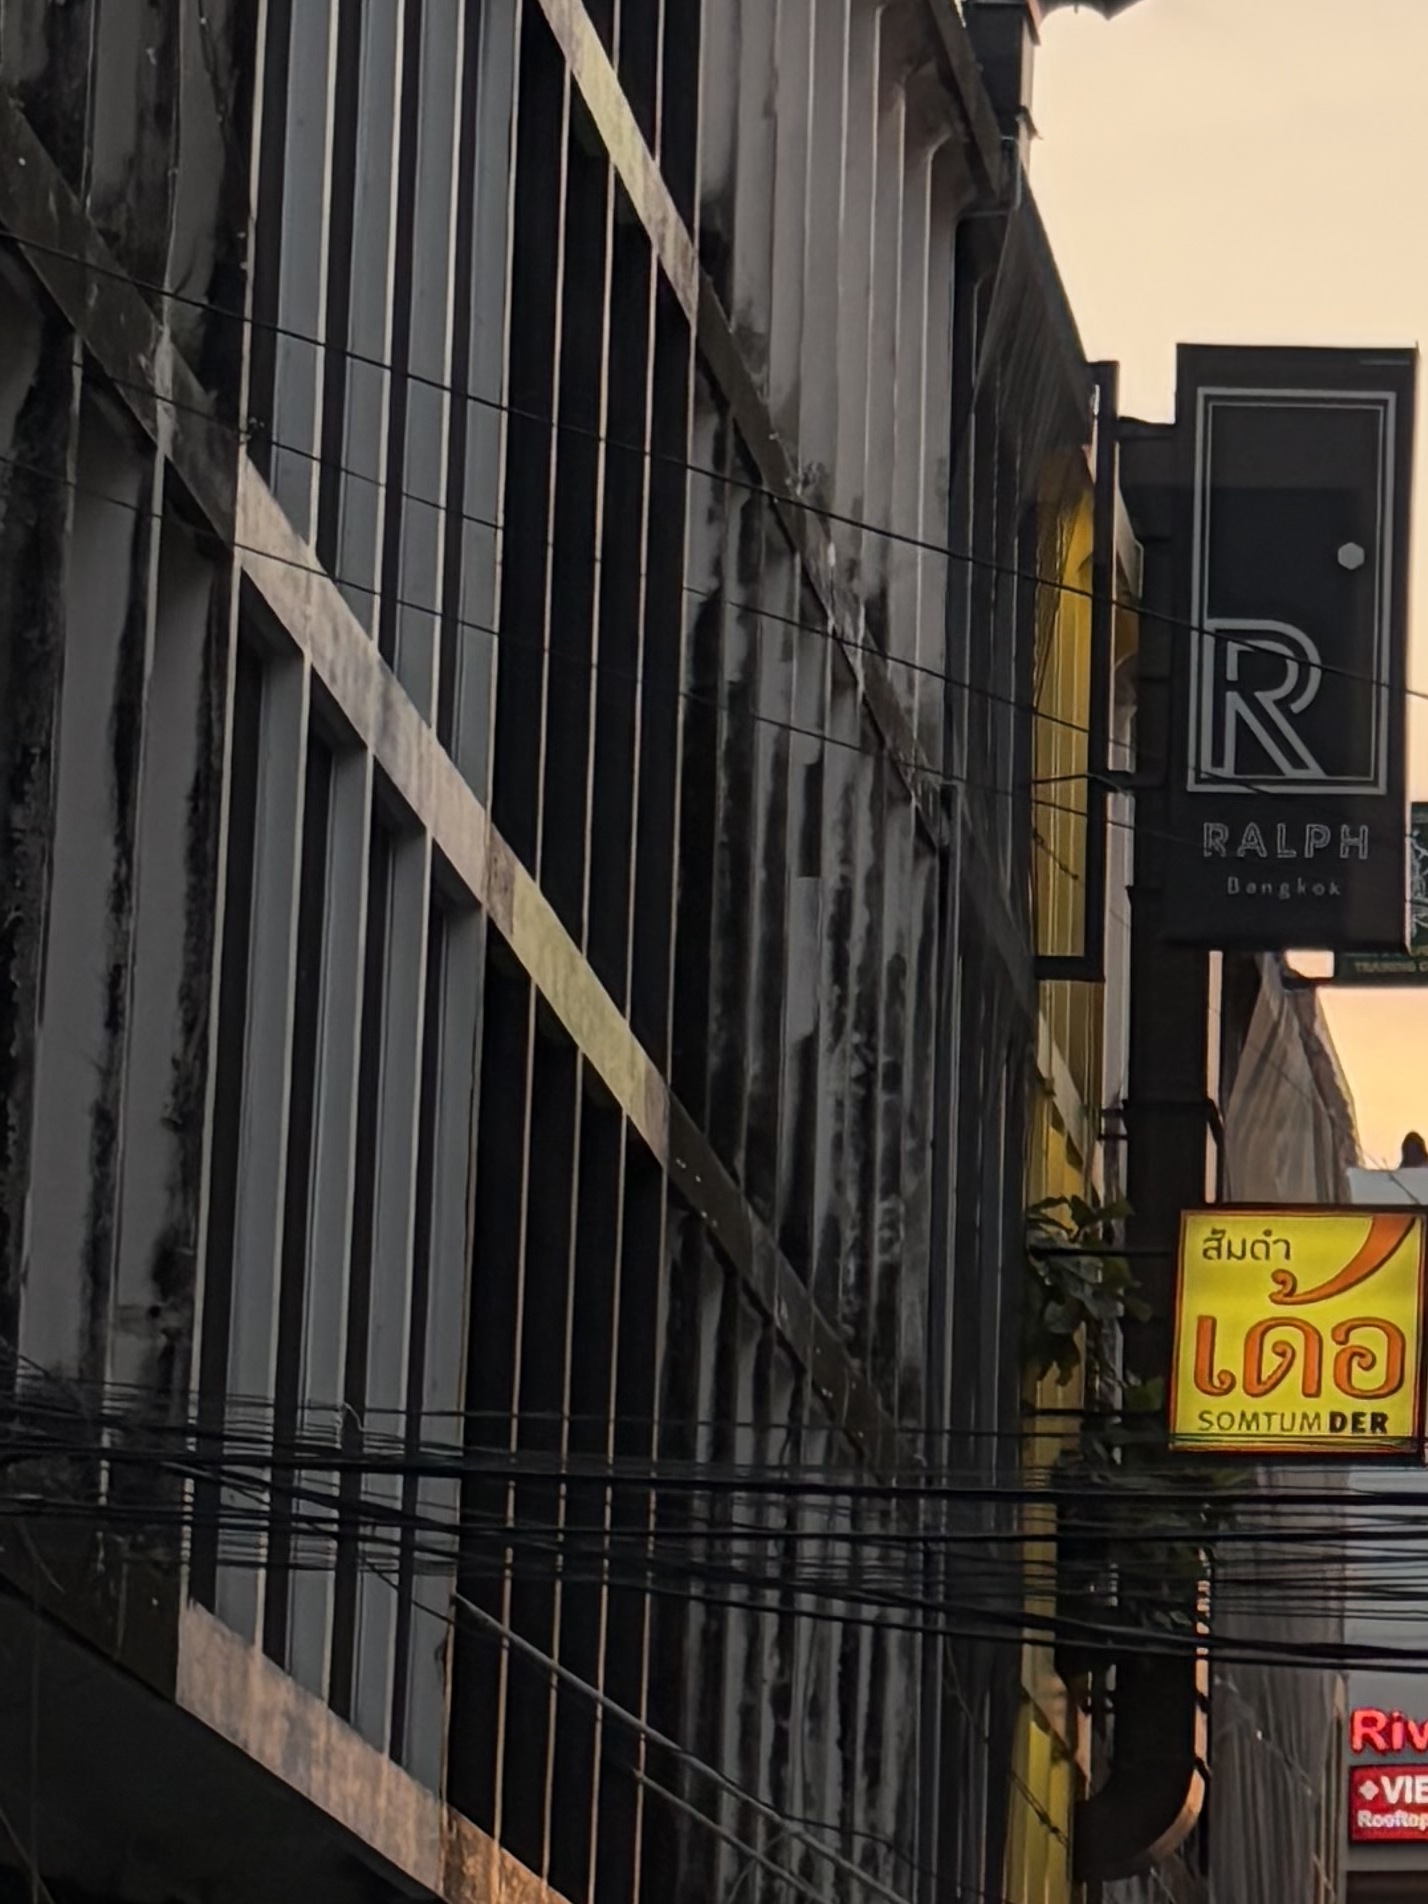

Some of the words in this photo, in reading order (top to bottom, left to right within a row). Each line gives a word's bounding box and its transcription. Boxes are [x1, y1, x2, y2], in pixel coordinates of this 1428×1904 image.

[1202, 821, 1370, 860] RALPH
[1227, 875, 1341, 900] Bangkok
[1197, 1409, 1322, 1433] SOMTUM
[1327, 1410, 1390, 1435] DER
